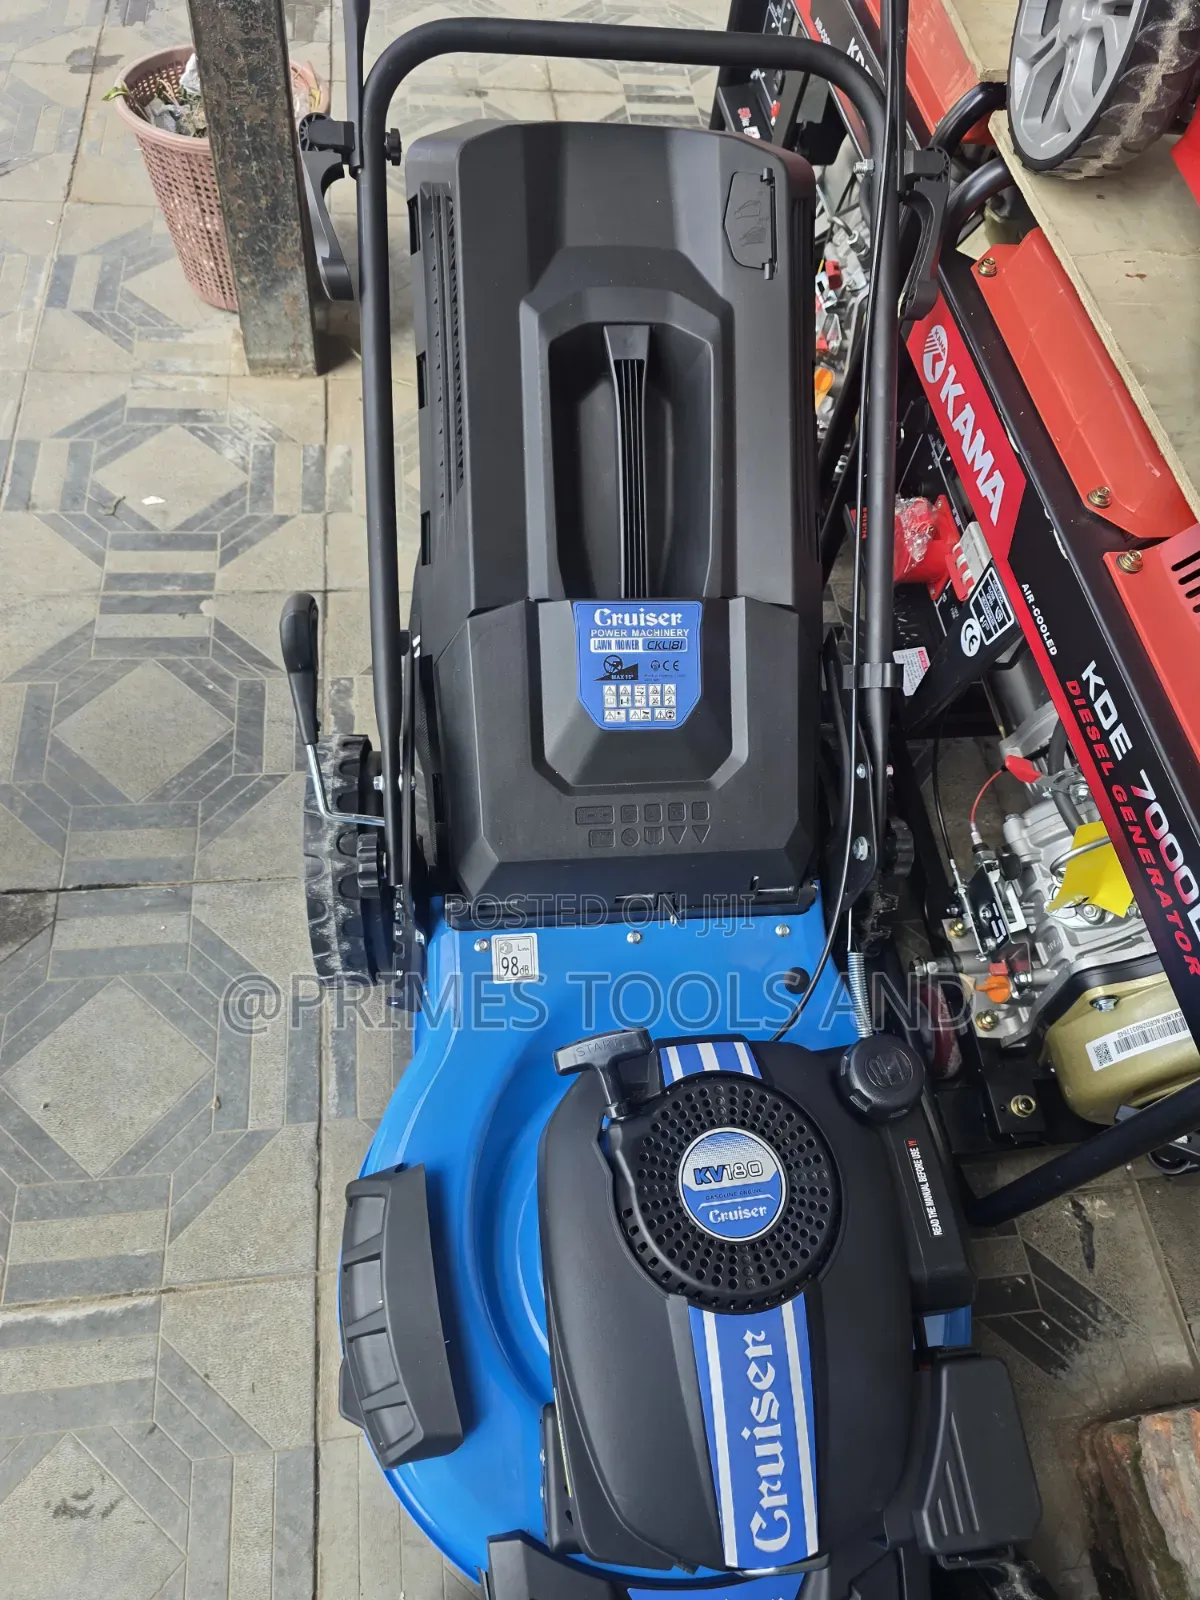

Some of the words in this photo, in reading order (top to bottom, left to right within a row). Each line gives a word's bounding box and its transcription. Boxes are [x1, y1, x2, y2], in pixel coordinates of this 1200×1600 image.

[940, 364, 1005, 527] KAMA
[1021, 583, 1035, 604] AIR
[594, 607, 683, 626] Cruiser
[590, 629, 627, 637] POWER
[631, 628, 690, 637] MACHINERY
[593, 639, 612, 651] LAWN
[614, 639, 640, 651] MOWER
[1082, 660, 1133, 761] KDE
[1066, 680, 1115, 776] DIESEL
[1112, 784, 1200, 976] GENERATOR
[501, 956, 519, 976] 98
[519, 964, 530, 976] dB
[575, 1038, 619, 1057] START
[909, 1147, 921, 1160] USE
[693, 1160, 764, 1186] KV180
[913, 1159, 928, 1183] BEFORE
[705, 1191, 738, 1201] GASOLINE
[920, 1182, 935, 1207] MANUAL
[708, 1205, 767, 1224] Cruiser
[926, 1206, 938, 1219] THE
[929, 1219, 943, 1236] READ
[740, 1328, 791, 1553] Cruiser
